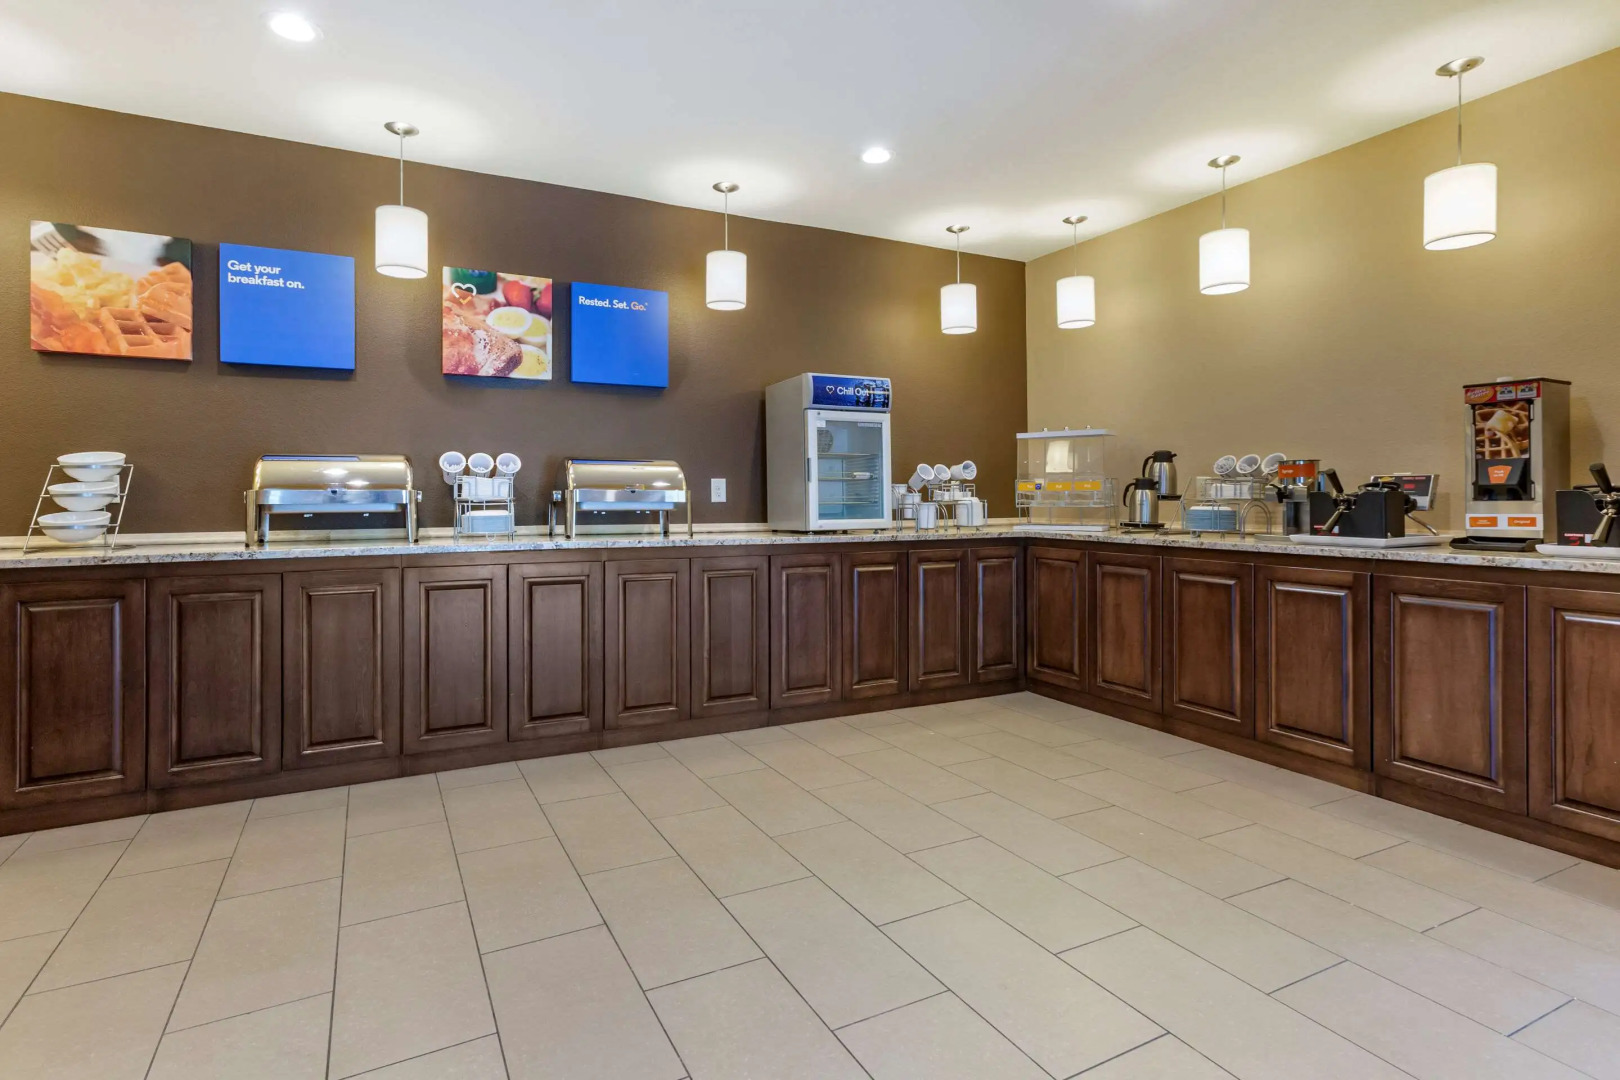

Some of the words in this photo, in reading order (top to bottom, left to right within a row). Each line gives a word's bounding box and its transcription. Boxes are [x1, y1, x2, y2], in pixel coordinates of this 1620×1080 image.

[227, 259, 252, 272] Get
[254, 264, 282, 275] your
[227, 272, 285, 288] breakfast
[286, 280, 305, 289] on.
[578, 295, 611, 308] Rested.
[612, 299, 630, 310] Set.
[836, 386, 854, 396] Chill
[854, 387, 870, 397] Out
